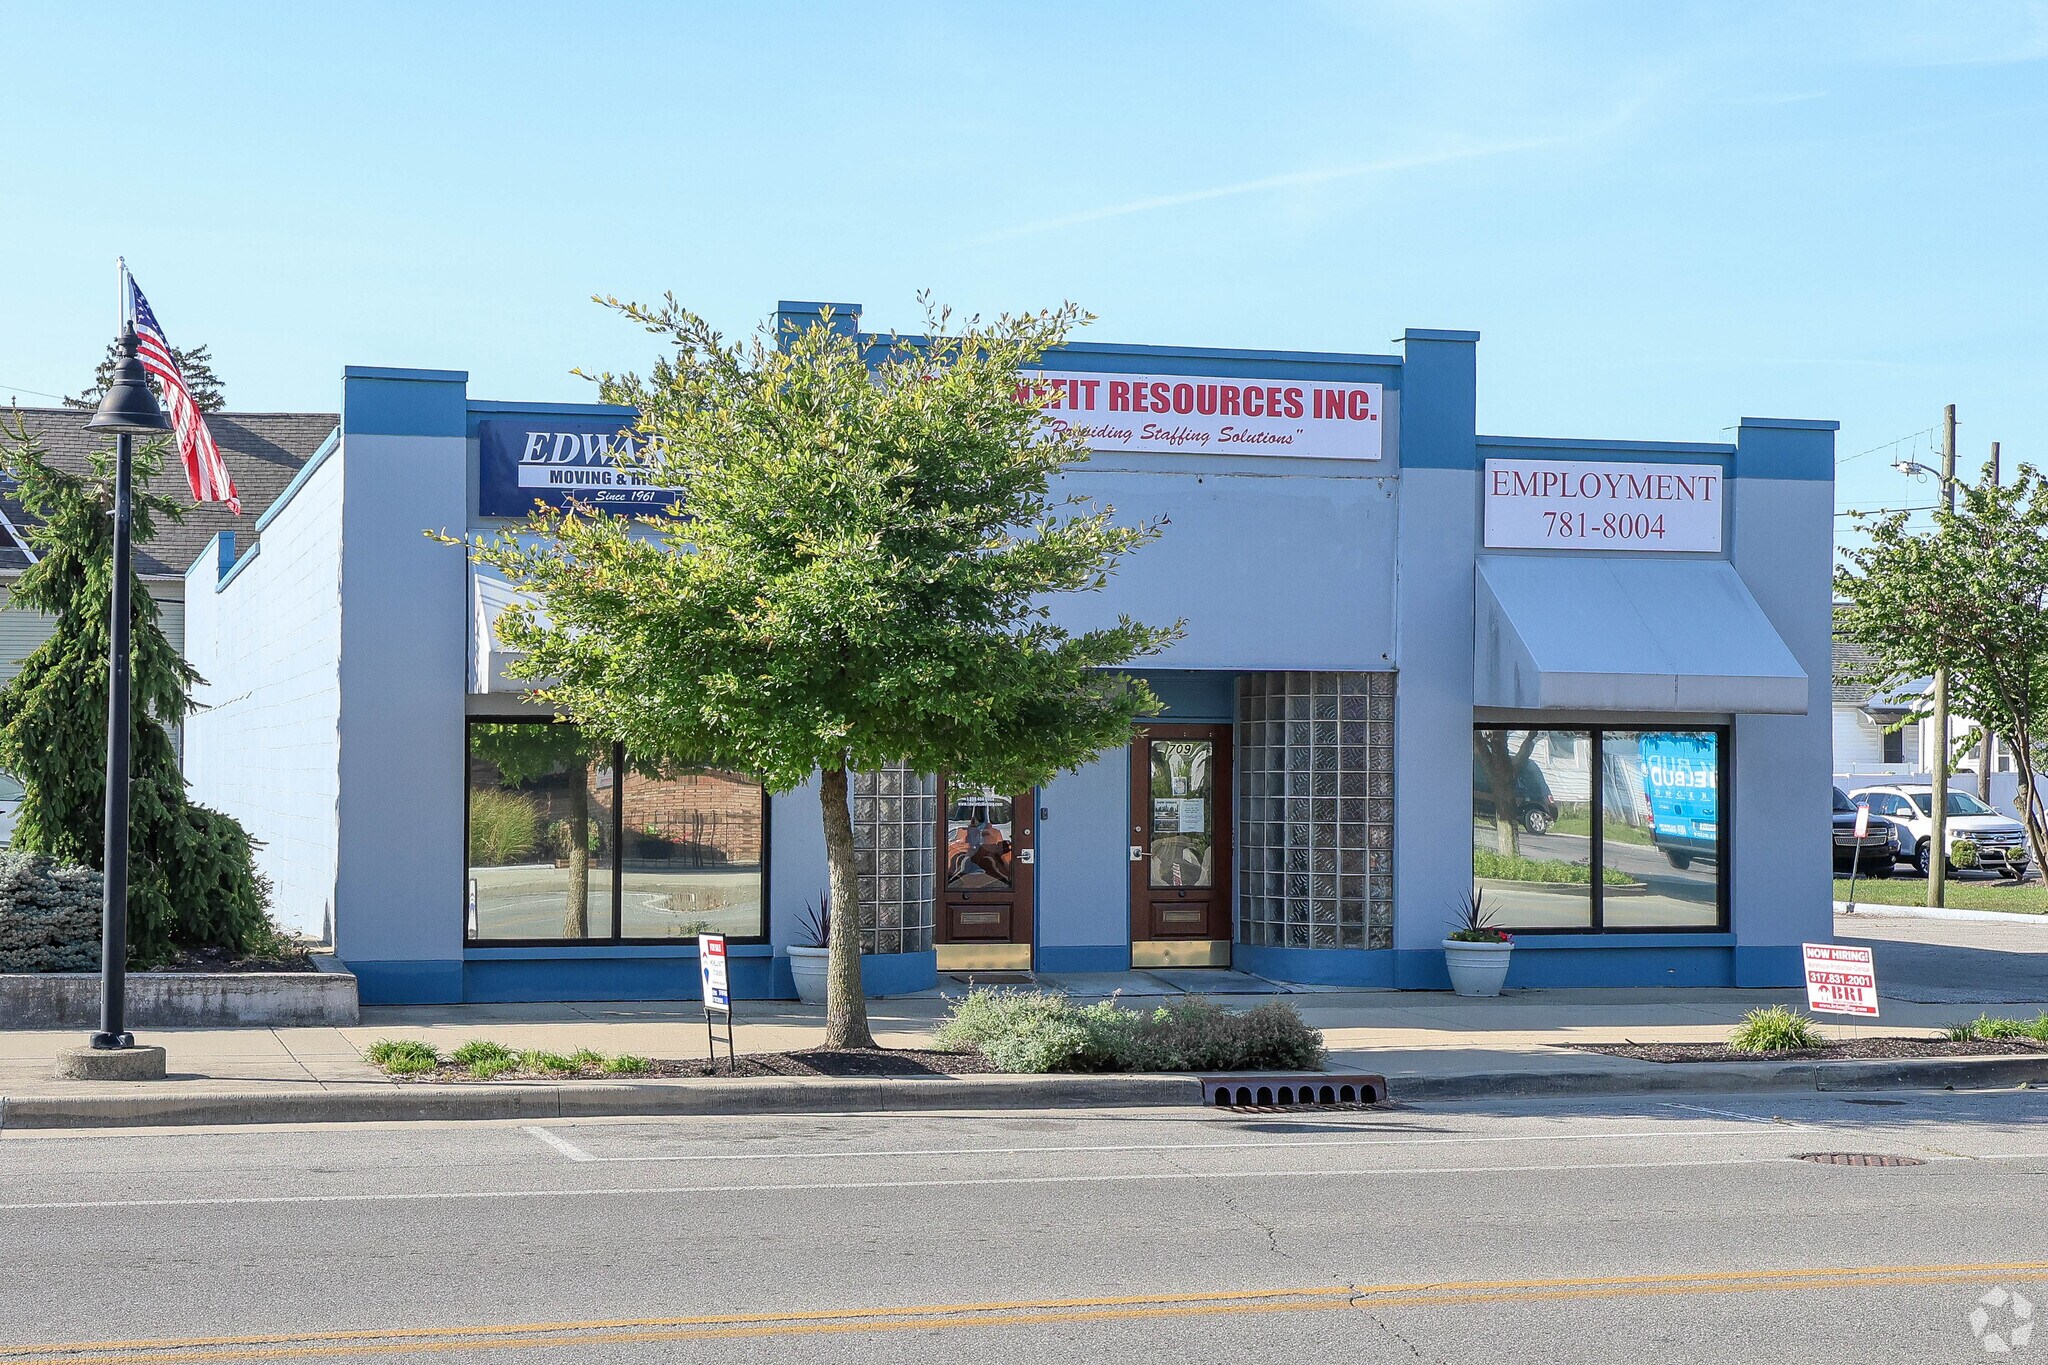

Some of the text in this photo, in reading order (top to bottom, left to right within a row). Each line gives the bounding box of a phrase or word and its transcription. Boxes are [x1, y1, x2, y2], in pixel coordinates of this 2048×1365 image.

[1011, 378, 1377, 421] NEFIT RESOURCES INC.
[1140, 423, 1211, 447] Staffing
[1218, 426, 1303, 445] Solutions"
[518, 431, 669, 465] EDWAR
[550, 469, 611, 486] MOVING
[616, 473, 627, 486] &
[1491, 470, 1717, 502] EMPLOYMENT
[595, 490, 656, 502] Since 1961
[1543, 511, 1666, 539] 781-8004
[1168, 744, 1191, 754] 709
[1807, 948, 1868, 961] NOW HIRING!
[1811, 973, 1869, 986] 317.831.2001
[1832, 986, 1863, 1000] BRI
